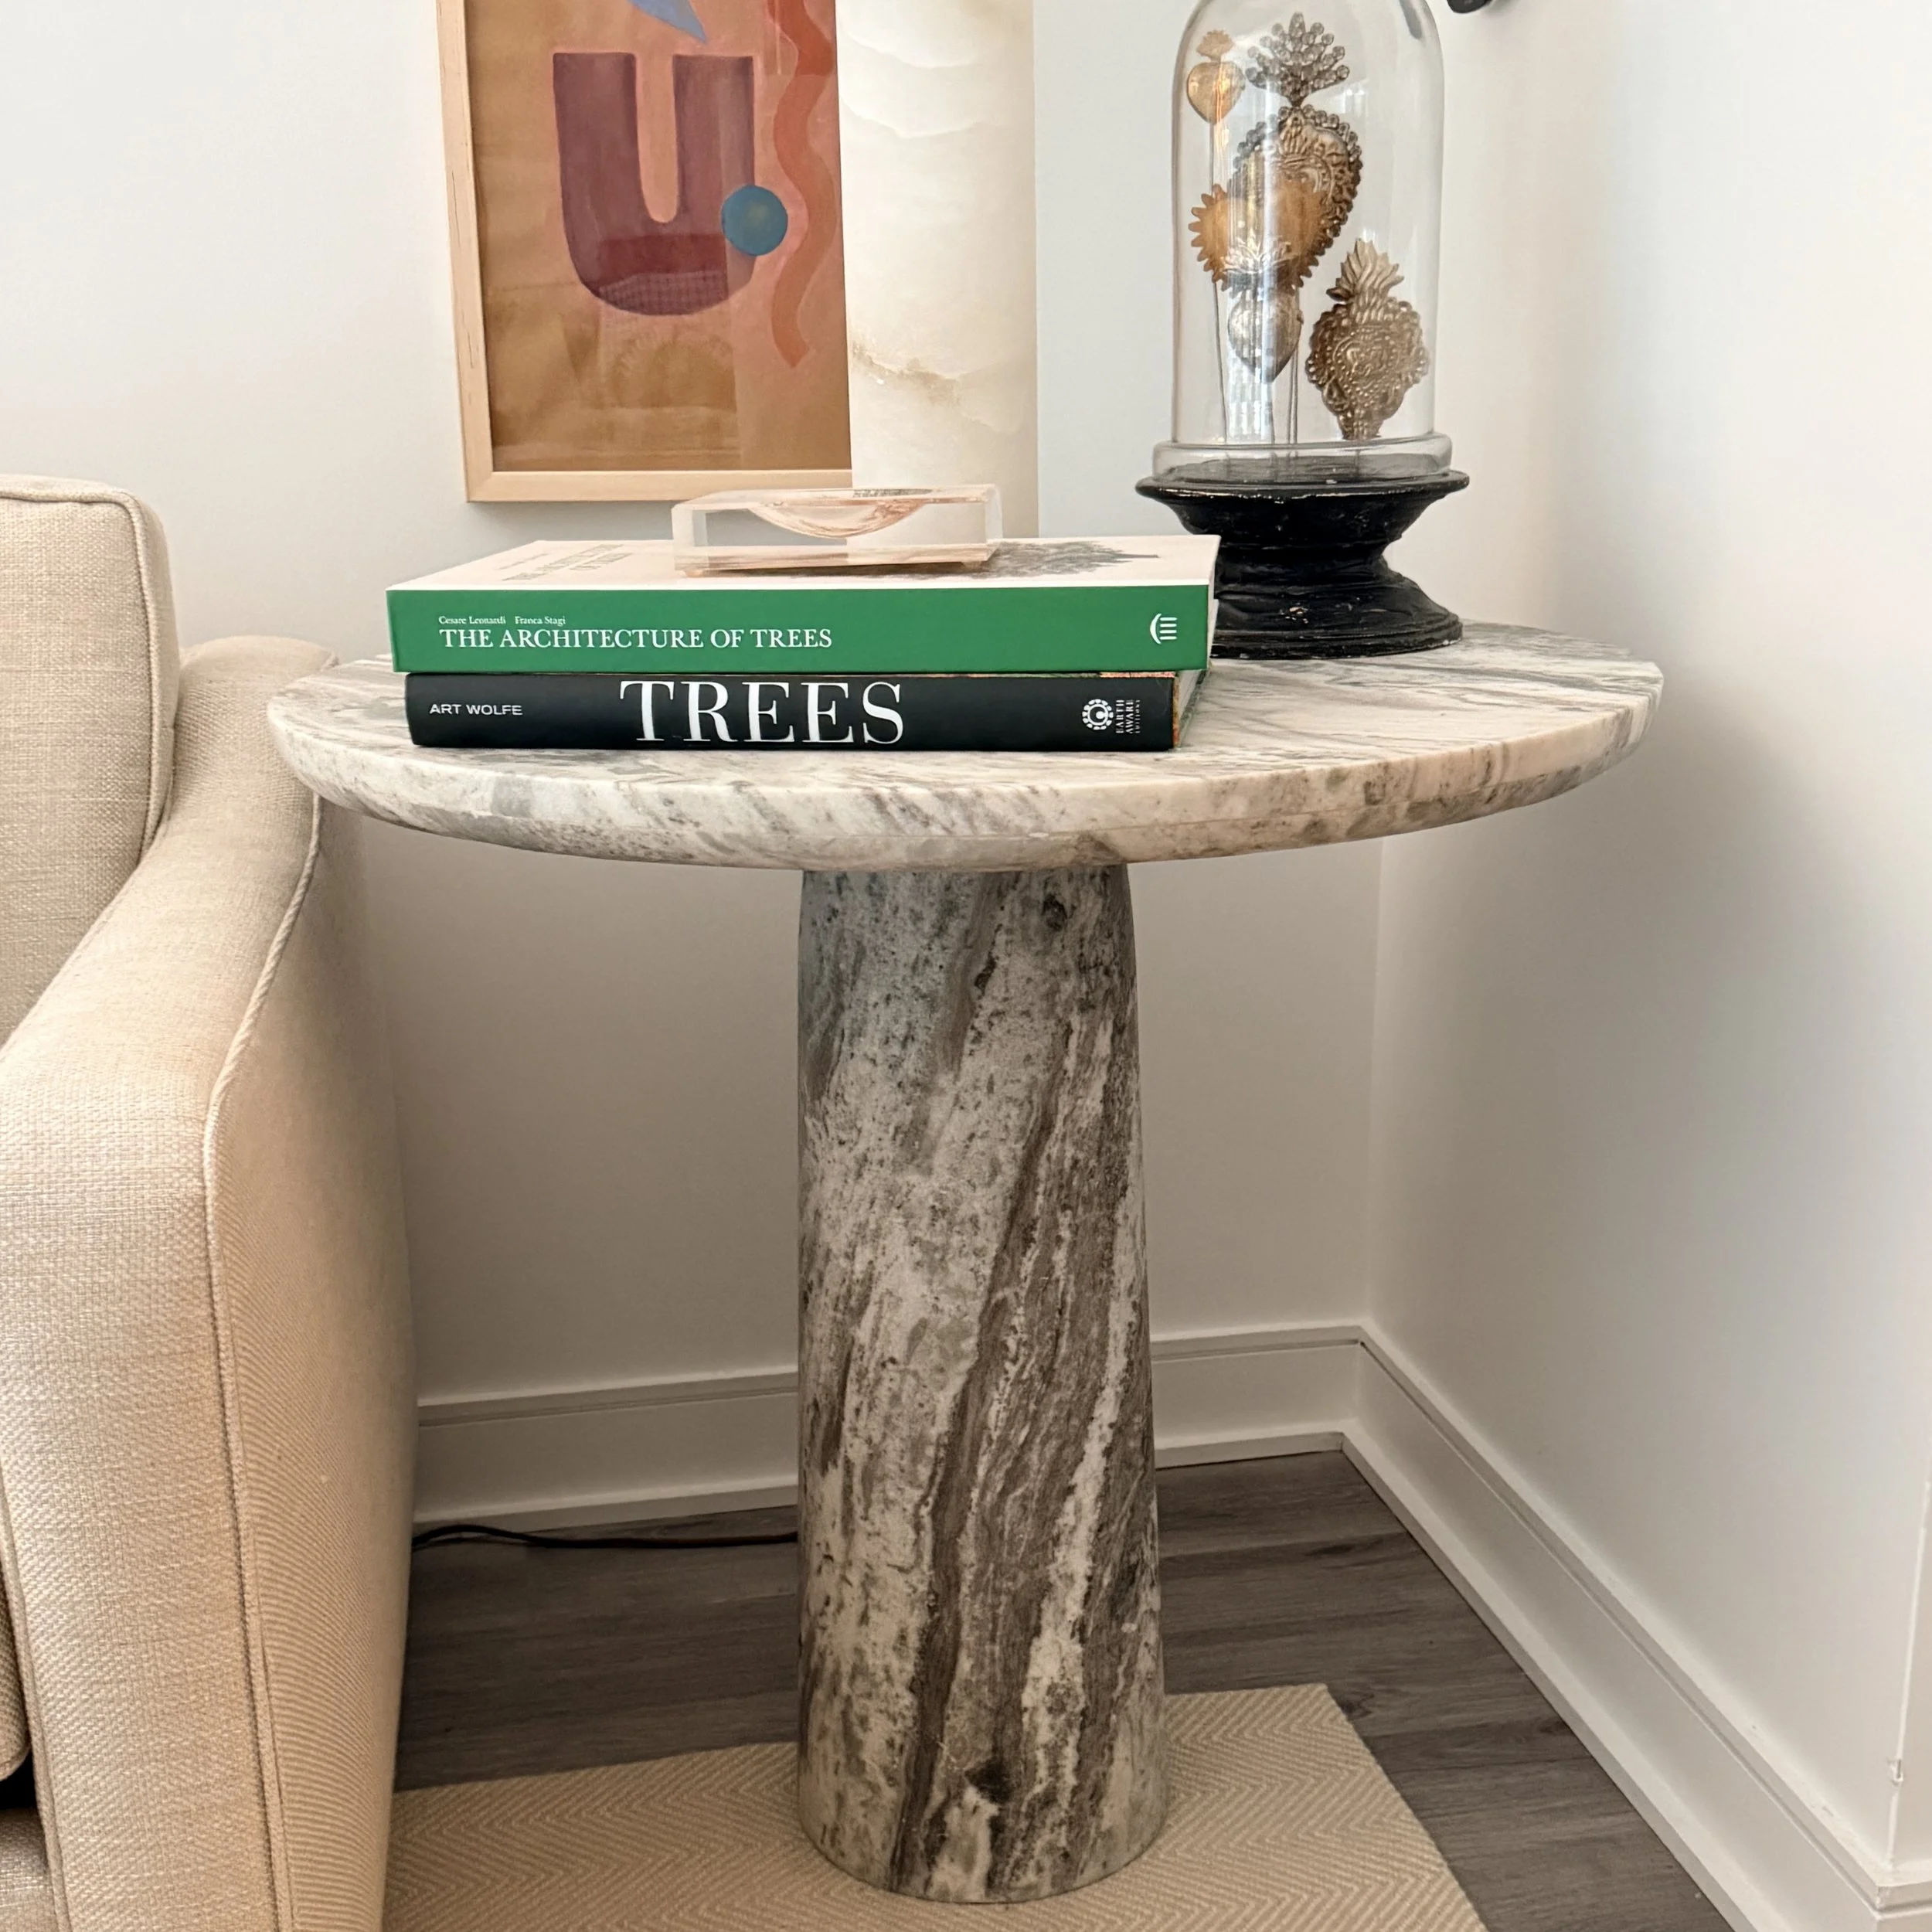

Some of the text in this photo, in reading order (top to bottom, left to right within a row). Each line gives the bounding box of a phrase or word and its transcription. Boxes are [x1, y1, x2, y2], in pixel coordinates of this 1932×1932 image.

[438, 615, 566, 627] Cesare Leonardi Franca Stagi
[438, 628, 832, 648] THE ARCHITECTURE OF TREES
[430, 703, 522, 716] ART WOLFE
[620, 681, 903, 744] TREES
[1115, 699, 1124, 733] EARTH
[1125, 699, 1134, 733] AWARE
